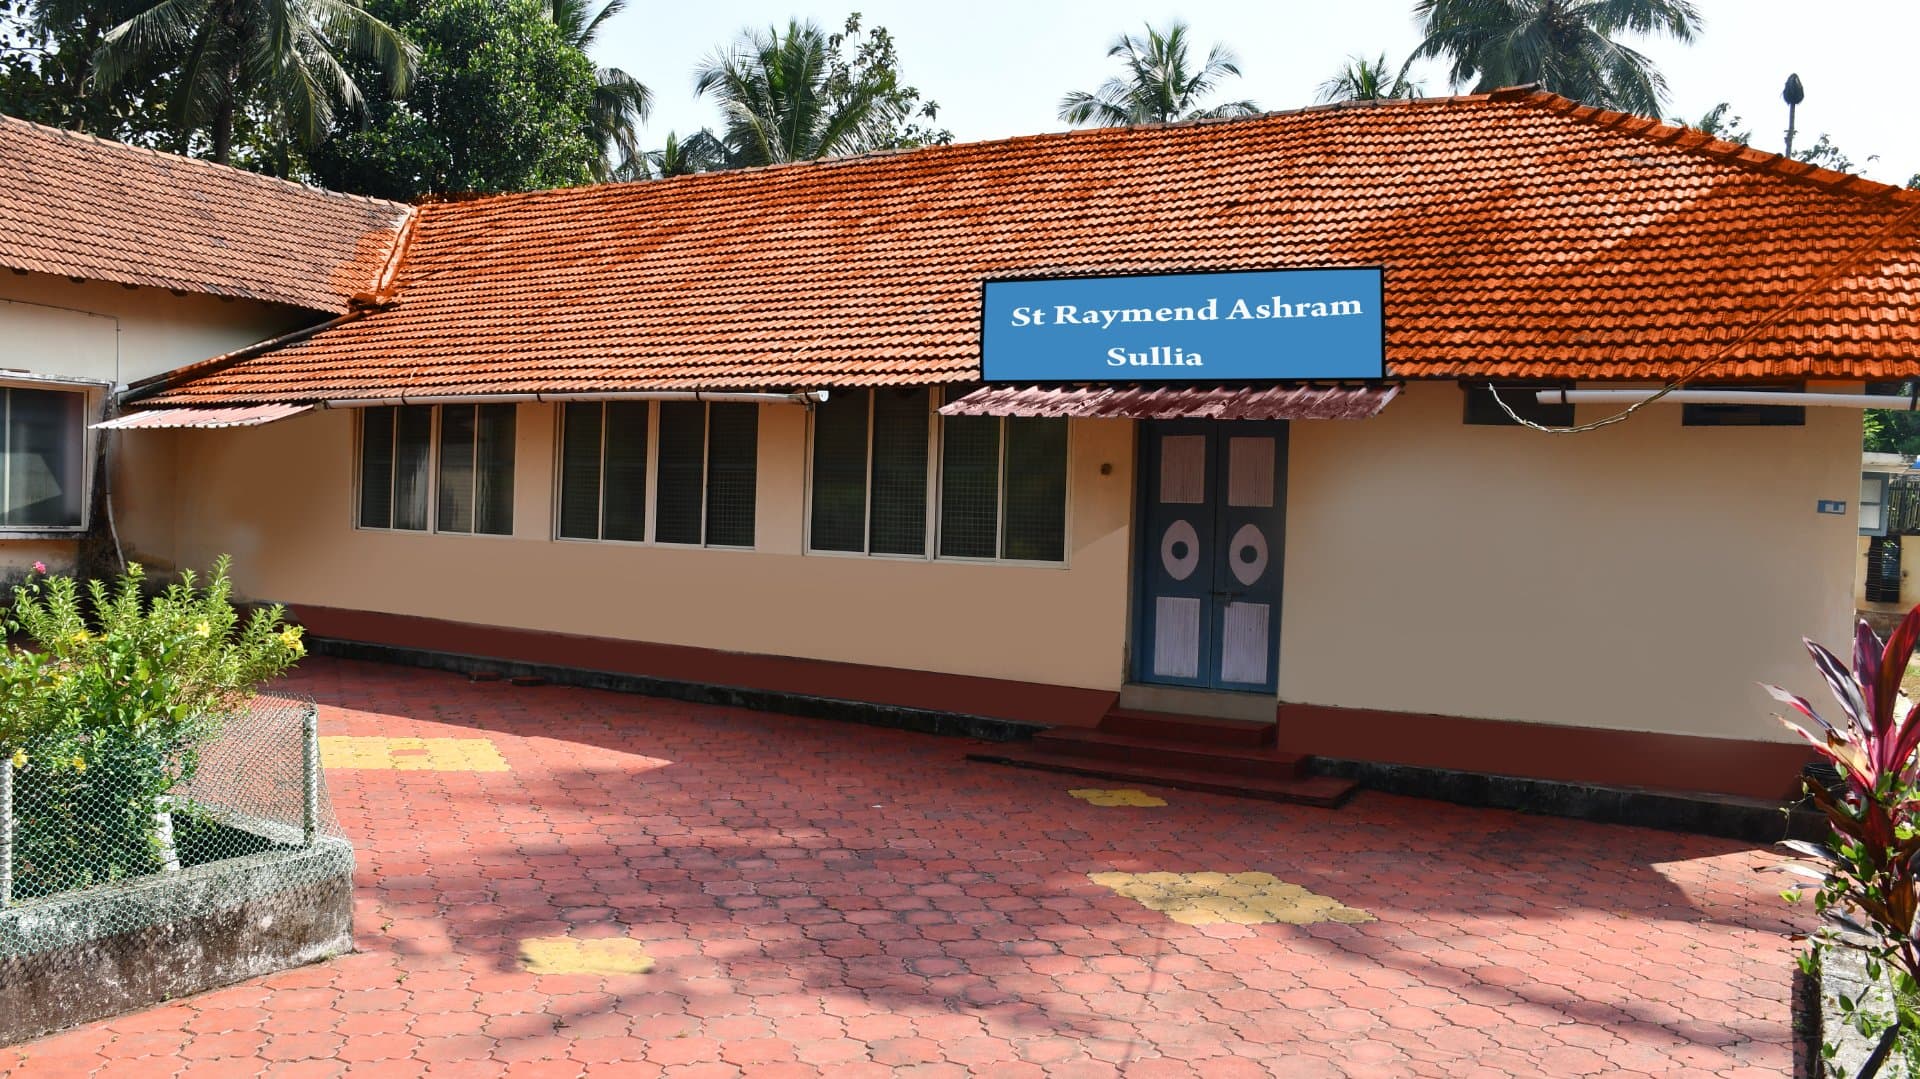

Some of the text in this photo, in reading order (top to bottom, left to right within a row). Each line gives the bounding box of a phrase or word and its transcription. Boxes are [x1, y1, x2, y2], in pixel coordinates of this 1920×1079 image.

[1010, 295, 1364, 329] St Raymend Ashram
[1106, 345, 1204, 367] Sullia
